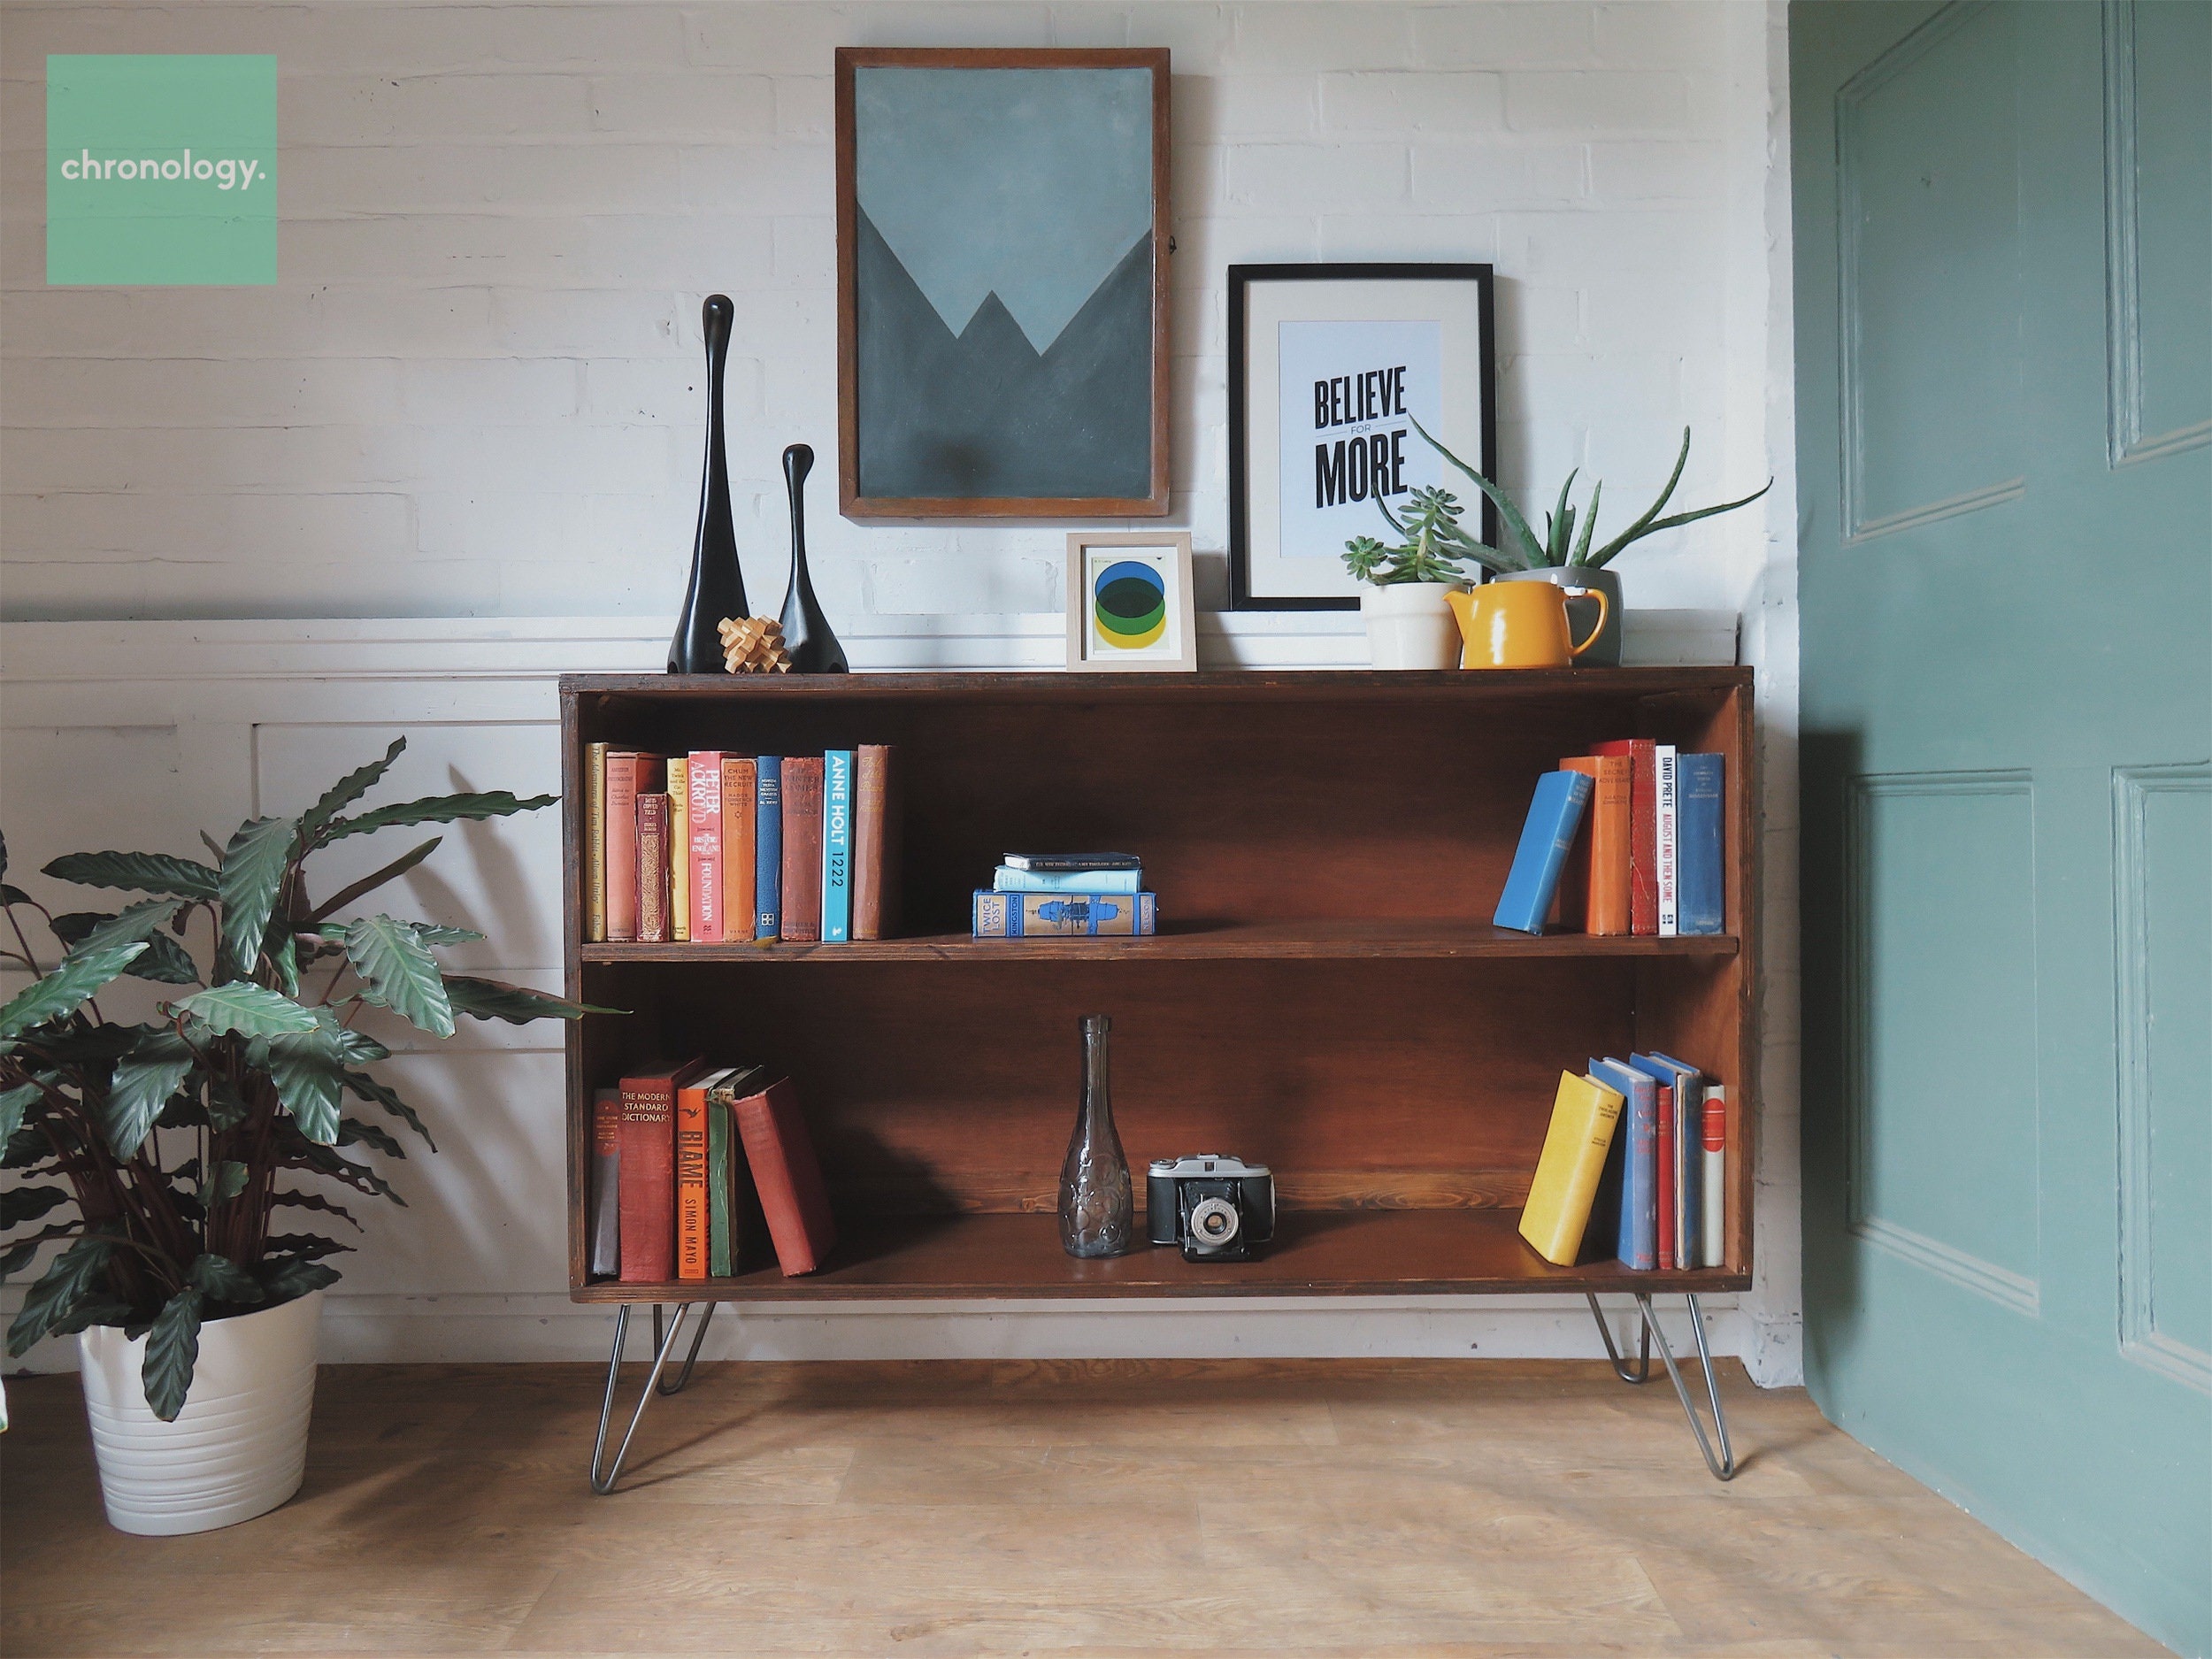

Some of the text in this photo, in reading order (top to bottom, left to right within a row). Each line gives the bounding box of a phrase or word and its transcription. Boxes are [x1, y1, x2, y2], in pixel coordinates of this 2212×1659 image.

[1315, 365, 1407, 429] BELIEVE
[1351, 424, 1371, 434] FOR
[1316, 429, 1408, 509] MORE
[691, 761, 706, 824] ACKROYD
[706, 769, 720, 814] PETER
[831, 756, 845, 887] ANNE HOLT 1222
[1663, 757, 1672, 902] DAVID PRETE AUGUST AND THEN SOME
[701, 863, 712, 921] FOUNDATION
[992, 902, 1001, 931] LOST
[622, 1113, 671, 1122] DICTIONARY
[624, 1102, 669, 1111] STANDARD
[637, 1093, 671, 1102] MODERN
[679, 1131, 703, 1188] BLAME
[685, 1199, 696, 1231] SIMON
[685, 1238, 697, 1263] MAYO
